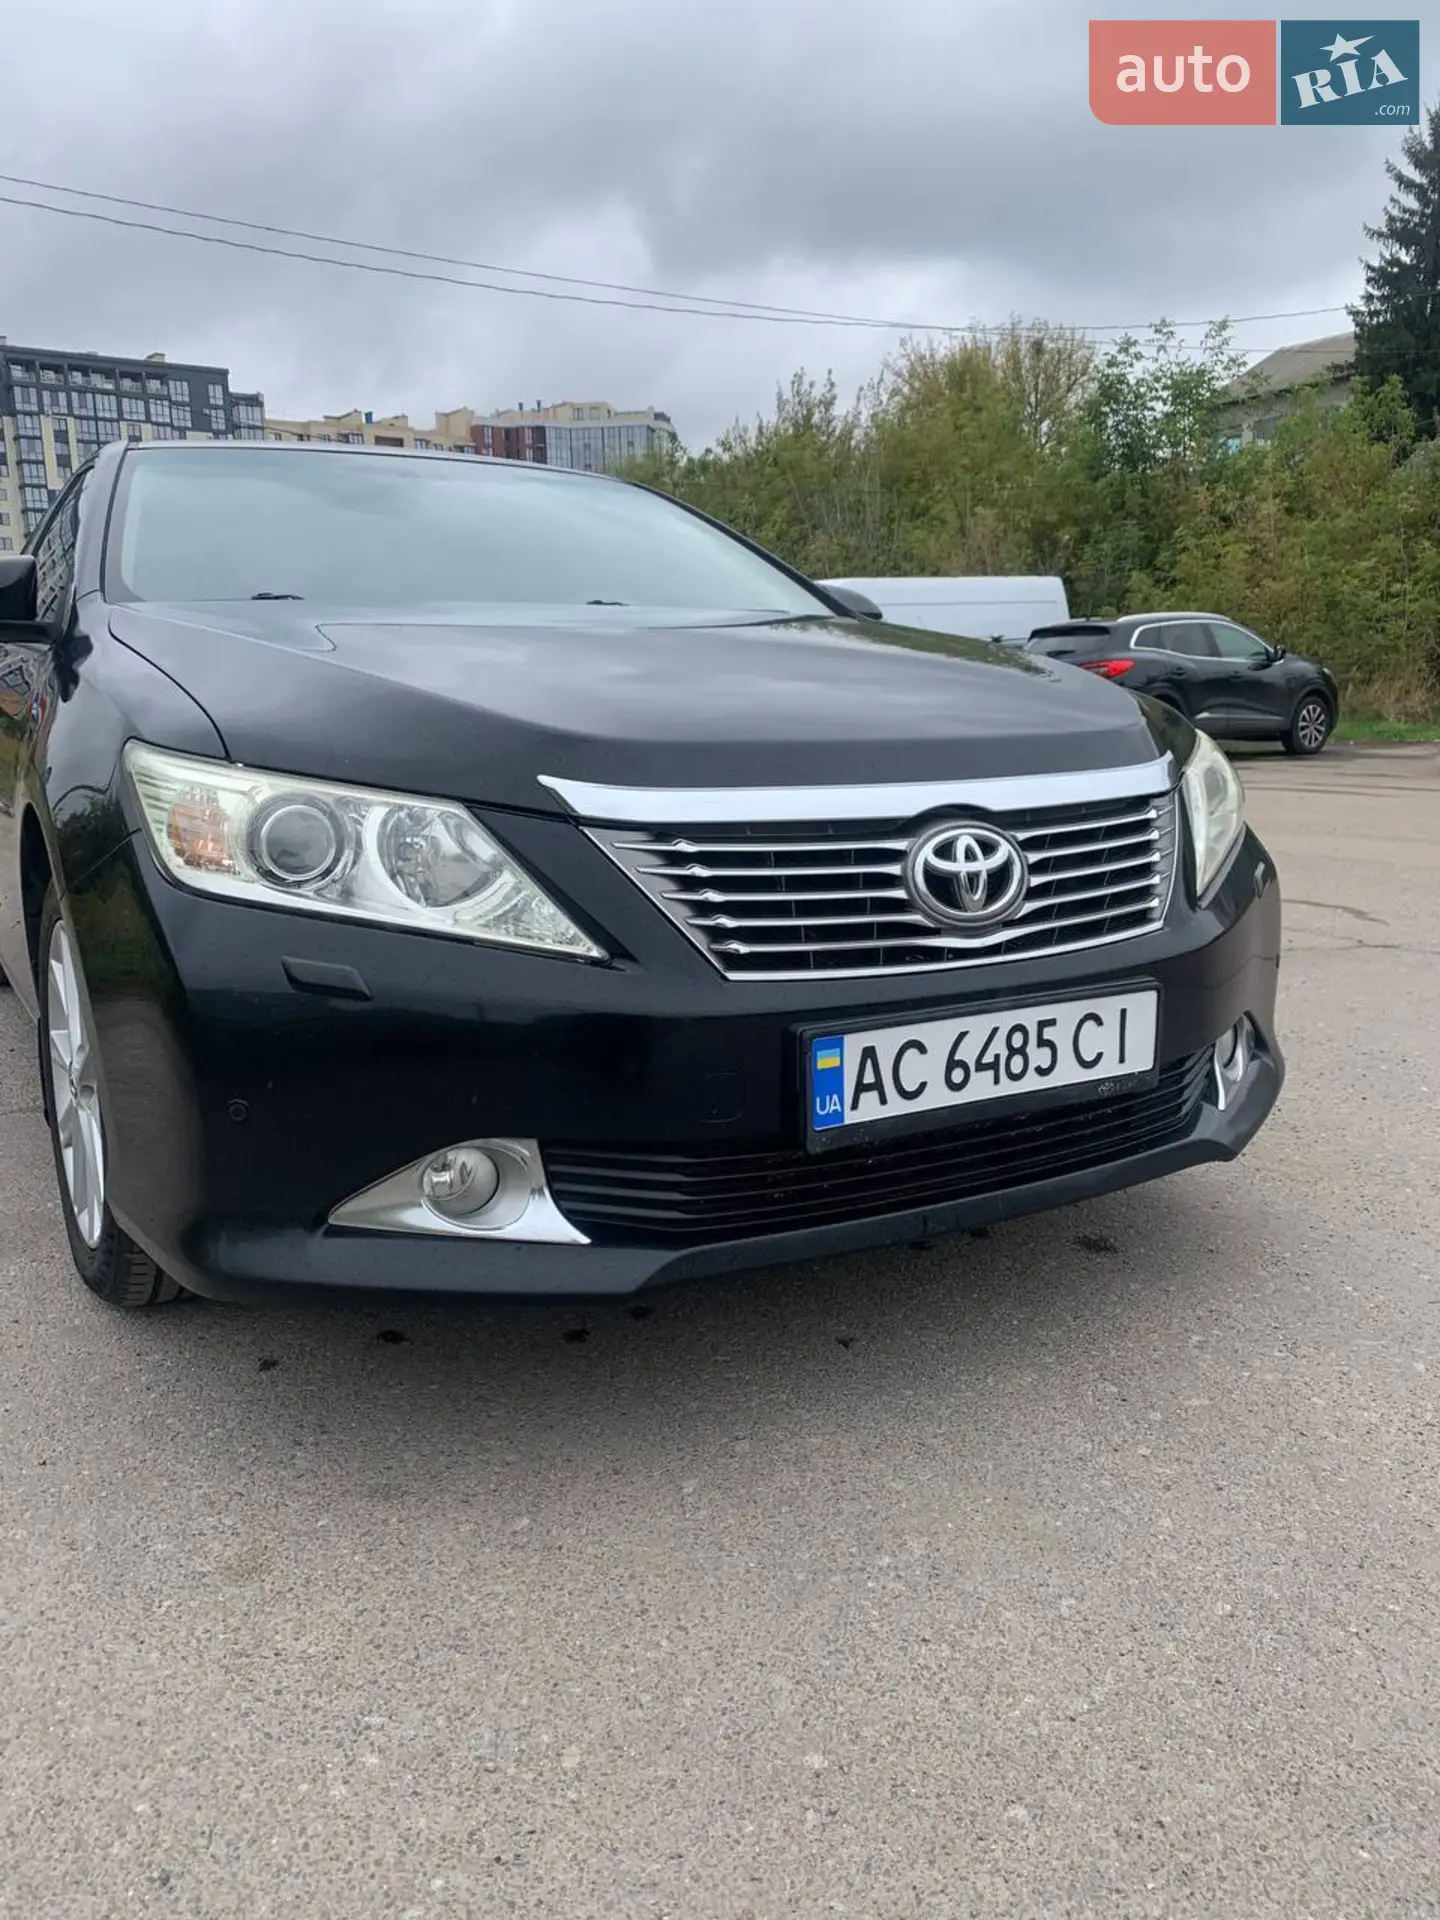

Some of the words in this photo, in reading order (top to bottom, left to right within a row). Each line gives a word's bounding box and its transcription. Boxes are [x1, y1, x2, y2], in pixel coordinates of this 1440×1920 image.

[850, 1039, 928, 1111] AC
[944, 1018, 1058, 1092] 6485
[1072, 1008, 1128, 1070] CI
[815, 1096, 842, 1116] UA
